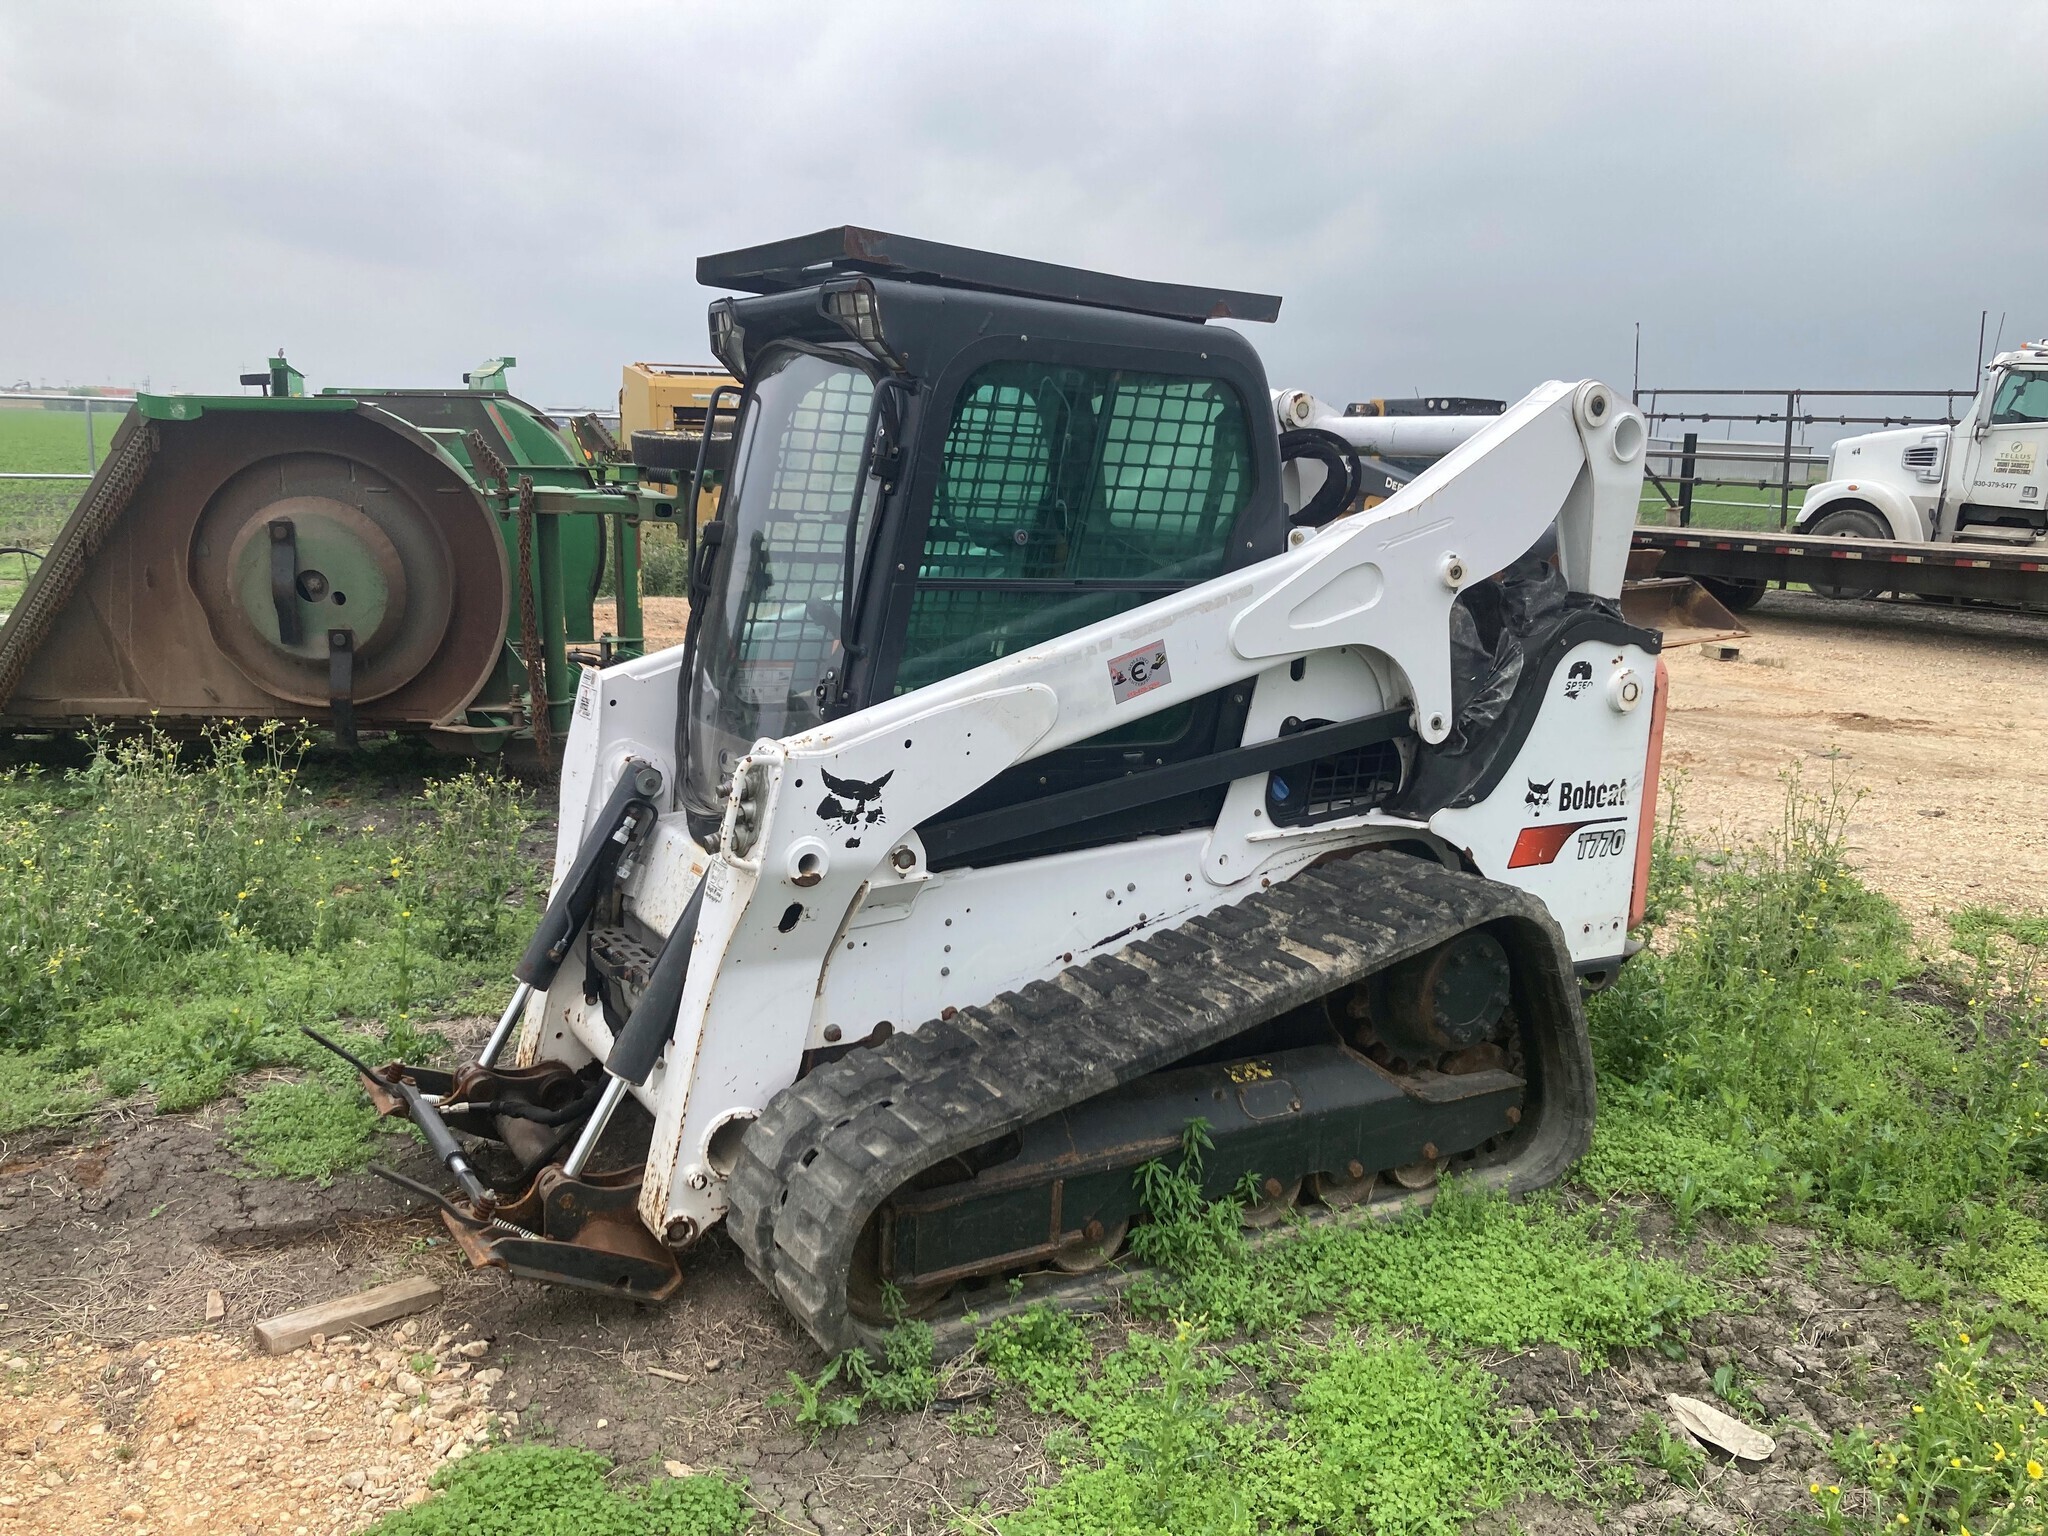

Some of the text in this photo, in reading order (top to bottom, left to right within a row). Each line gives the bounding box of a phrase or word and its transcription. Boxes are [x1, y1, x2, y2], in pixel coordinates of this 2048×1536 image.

[2000, 452, 2031, 460] TELLUS
[1385, 476, 1404, 491] DEE
[1558, 779, 1627, 812] Bobcat
[1577, 829, 1626, 860] T770
